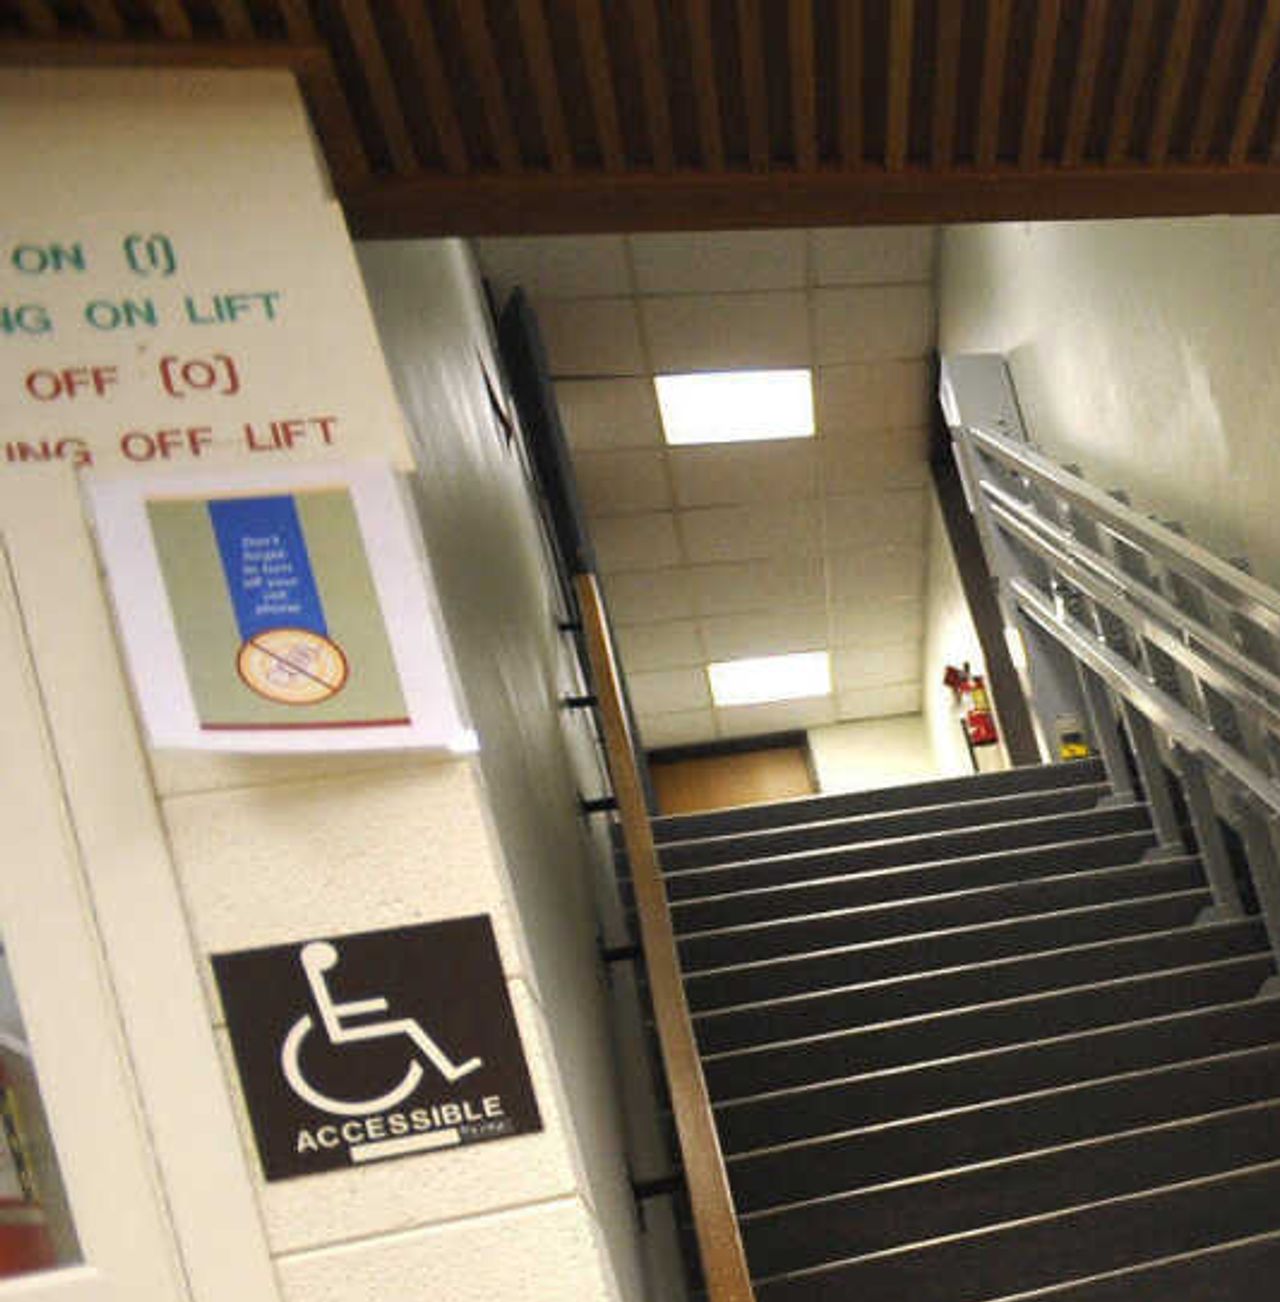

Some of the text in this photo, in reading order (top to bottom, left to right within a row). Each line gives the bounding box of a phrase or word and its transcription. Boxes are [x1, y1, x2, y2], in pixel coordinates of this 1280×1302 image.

[11, 243, 86, 274] ON
[84, 297, 158, 330] ON
[184, 292, 280, 325] LIFT
[25, 365, 118, 401] OFF
[119, 426, 213, 462] OFF
[243, 415, 337, 452] LIFT
[295, 1094, 504, 1154] ACCESSIBLE
